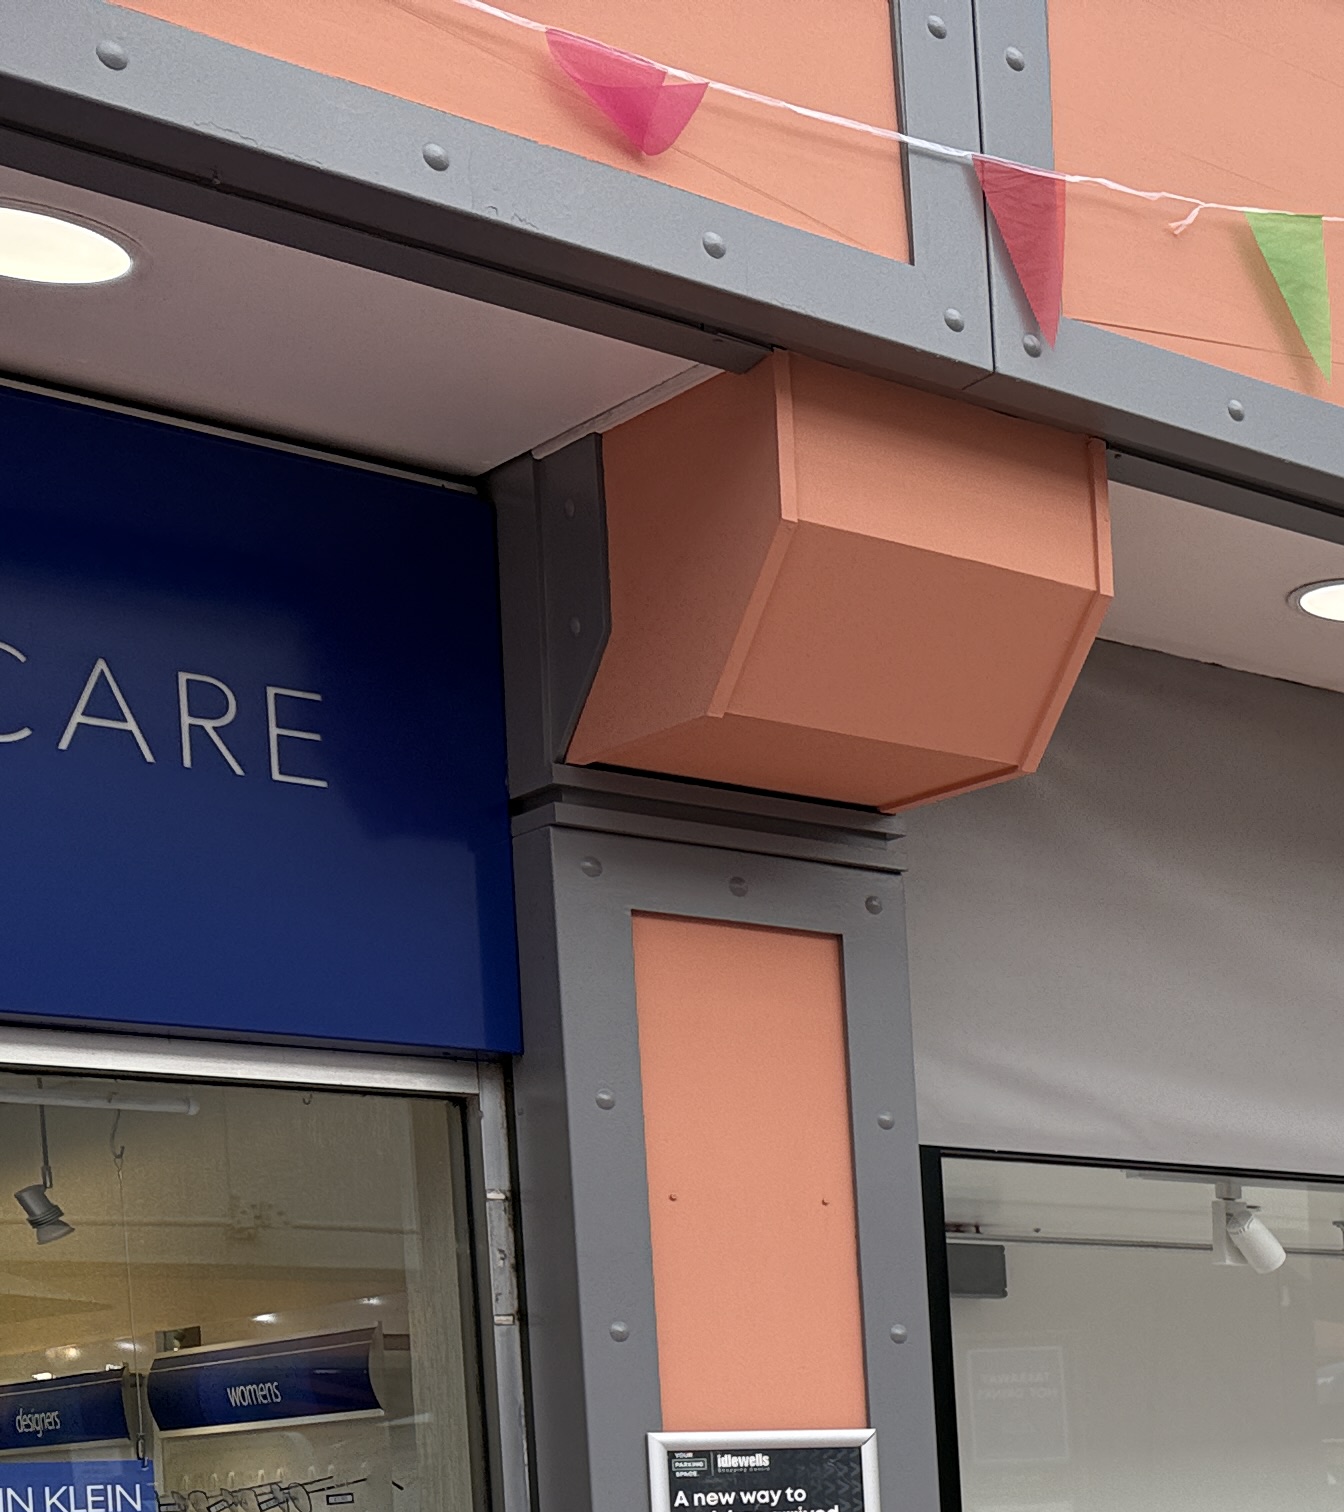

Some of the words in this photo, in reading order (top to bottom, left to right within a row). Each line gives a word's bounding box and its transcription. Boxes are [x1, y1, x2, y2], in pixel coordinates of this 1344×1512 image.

[226, 1381, 282, 1408] womens
[15, 1407, 61, 1437] designers
[716, 1452, 771, 1468] idlewells
[674, 1490, 690, 1508] A
[693, 1491, 736, 1507] new
[740, 1489, 783, 1507] way
[784, 1486, 807, 1502] to
